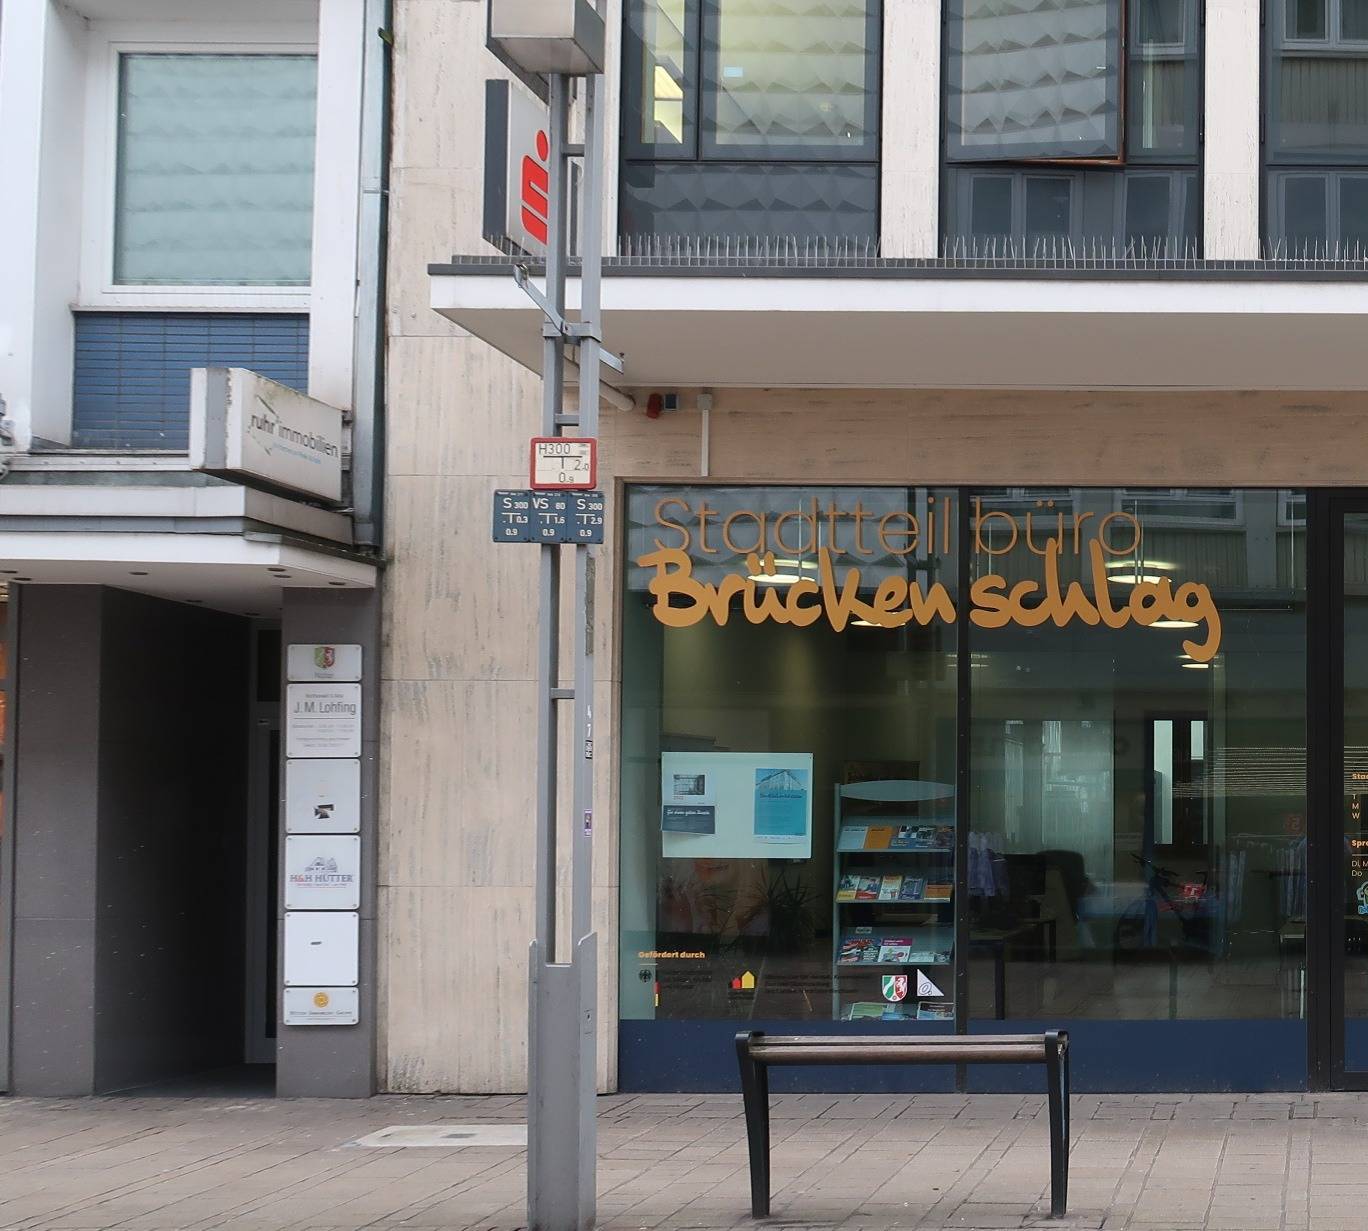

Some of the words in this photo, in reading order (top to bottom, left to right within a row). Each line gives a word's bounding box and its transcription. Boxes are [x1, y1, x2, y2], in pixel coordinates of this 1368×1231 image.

[251, 413, 275, 434] ruhr
[278, 421, 339, 458] immobilien
[538, 443, 571, 455] H300
[558, 472, 574, 483] 0.9
[503, 498, 512, 509] S
[532, 498, 549, 509] VS
[577, 499, 586, 510] S
[654, 497, 952, 555] Stadtteil
[975, 499, 1142, 555] büro
[505, 528, 518, 536] 0.9
[637, 547, 957, 633] Brücken
[970, 537, 1222, 662] schlag
[319, 701, 356, 715] Lohfing
[680, 951, 705, 959] durch
